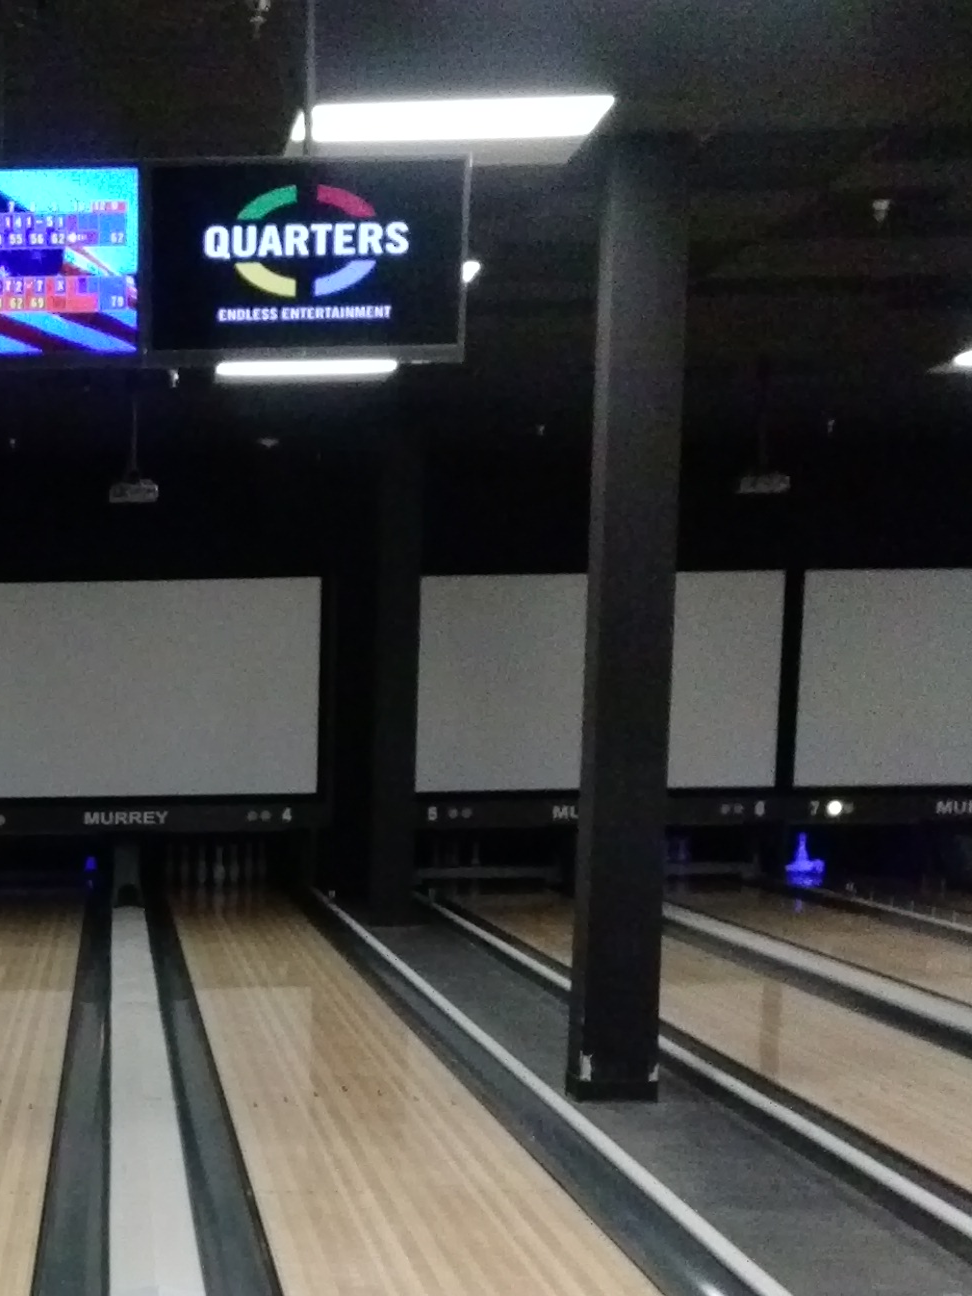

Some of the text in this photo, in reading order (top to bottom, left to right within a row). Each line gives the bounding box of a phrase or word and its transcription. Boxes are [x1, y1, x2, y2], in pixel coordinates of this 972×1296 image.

[203, 221, 410, 260] QUARTERS
[217, 304, 391, 322] ENDLESS ENTERTAINMENT
[83, 810, 168, 826] MURREY
[281, 807, 292, 822] 4
